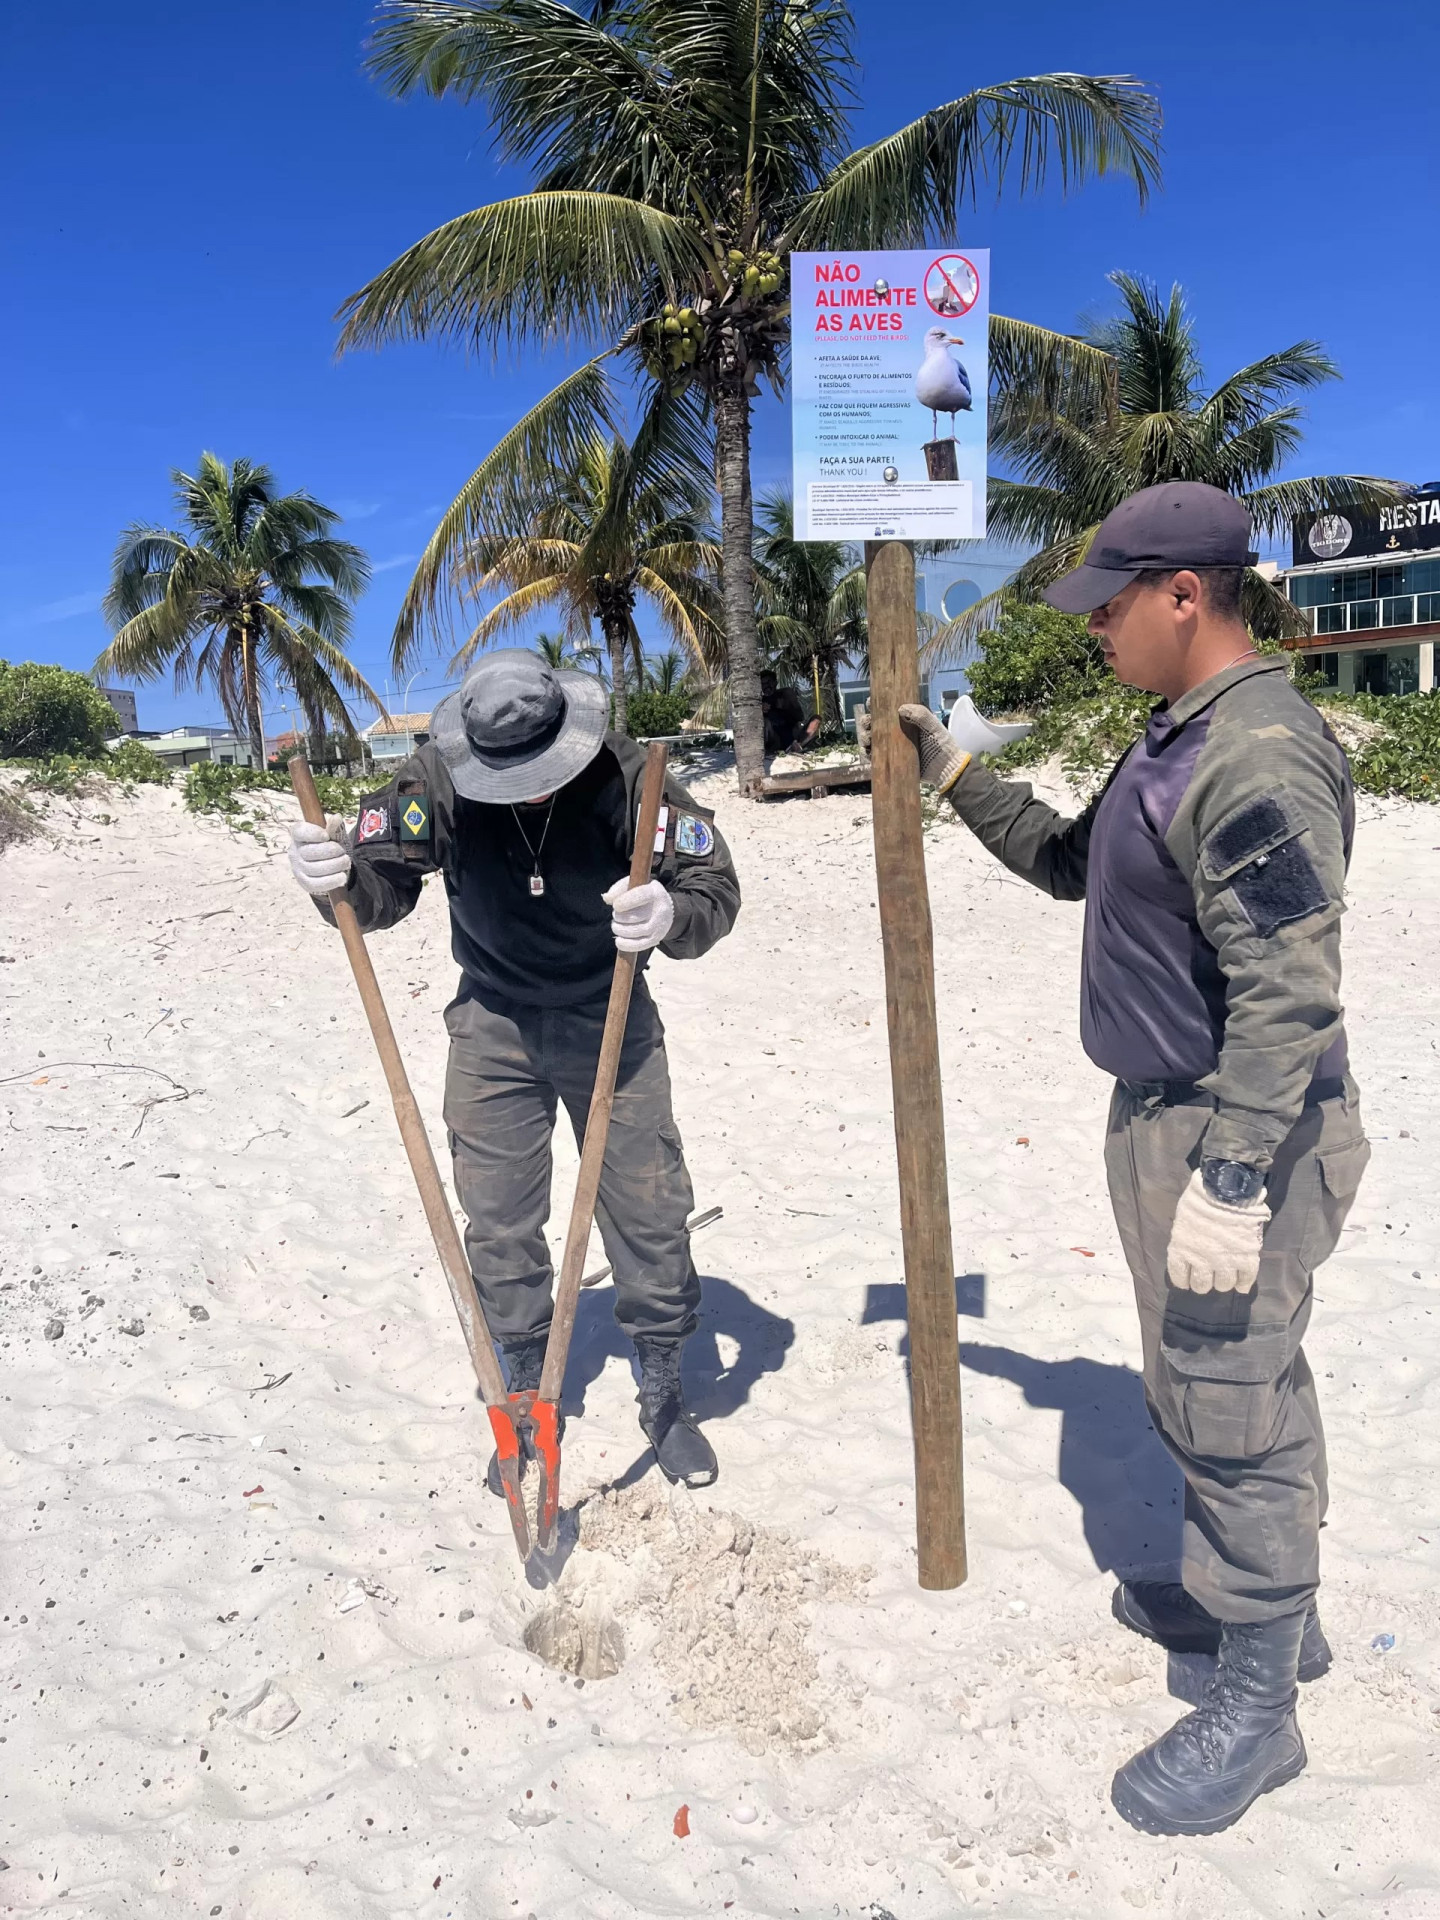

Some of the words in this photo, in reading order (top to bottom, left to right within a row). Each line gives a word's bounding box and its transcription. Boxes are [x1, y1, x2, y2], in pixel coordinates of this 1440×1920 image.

[815, 260, 860, 282] NÃO
[815, 288, 916, 306] ALIMENTE
[815, 313, 842, 332] AS
[849, 313, 903, 331] AVES
[820, 457, 839, 465] FAÇA
